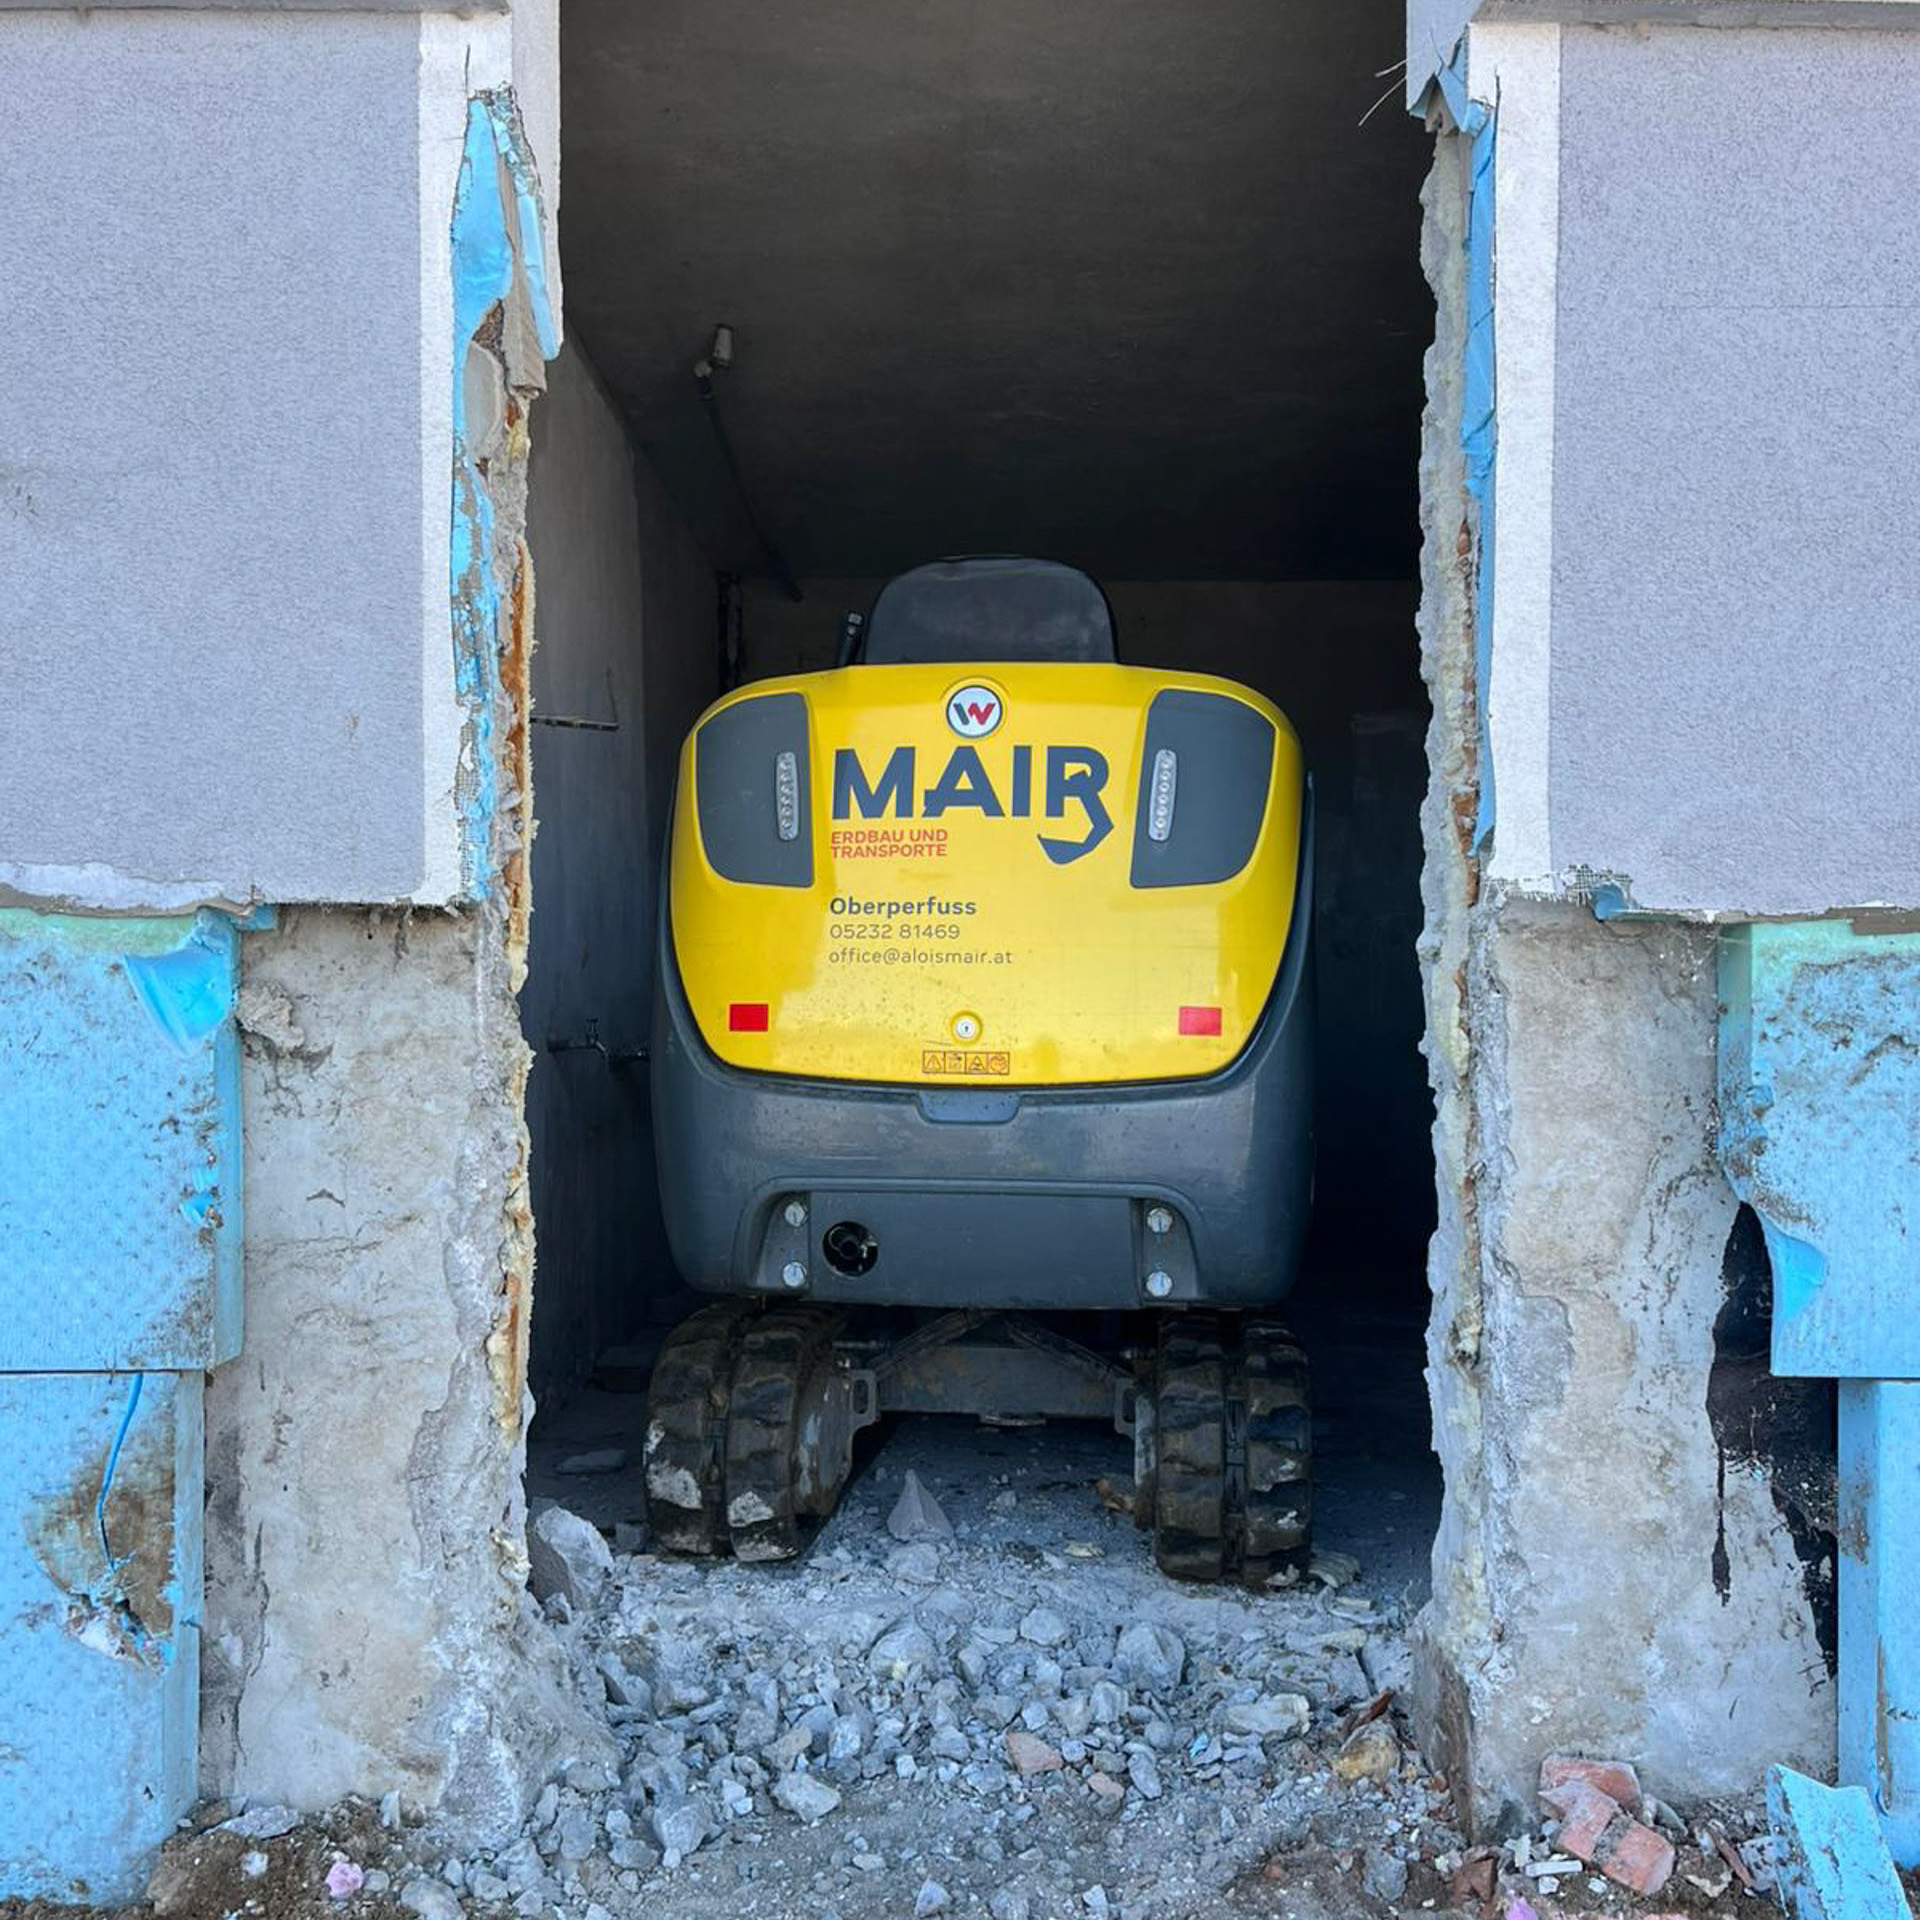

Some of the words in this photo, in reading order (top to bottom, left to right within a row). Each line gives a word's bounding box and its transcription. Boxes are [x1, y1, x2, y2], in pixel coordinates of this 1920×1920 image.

[832, 745, 1114, 865] MAIR
[831, 830, 905, 845] ERDBAU
[908, 828, 948, 843] UND
[831, 844, 947, 859] TRANSPORTE
[830, 896, 977, 918] Oberperfuss
[830, 924, 892, 940] 05232
[898, 923, 960, 940] 81469
[829, 947, 1013, 965] office@aloismair.at
